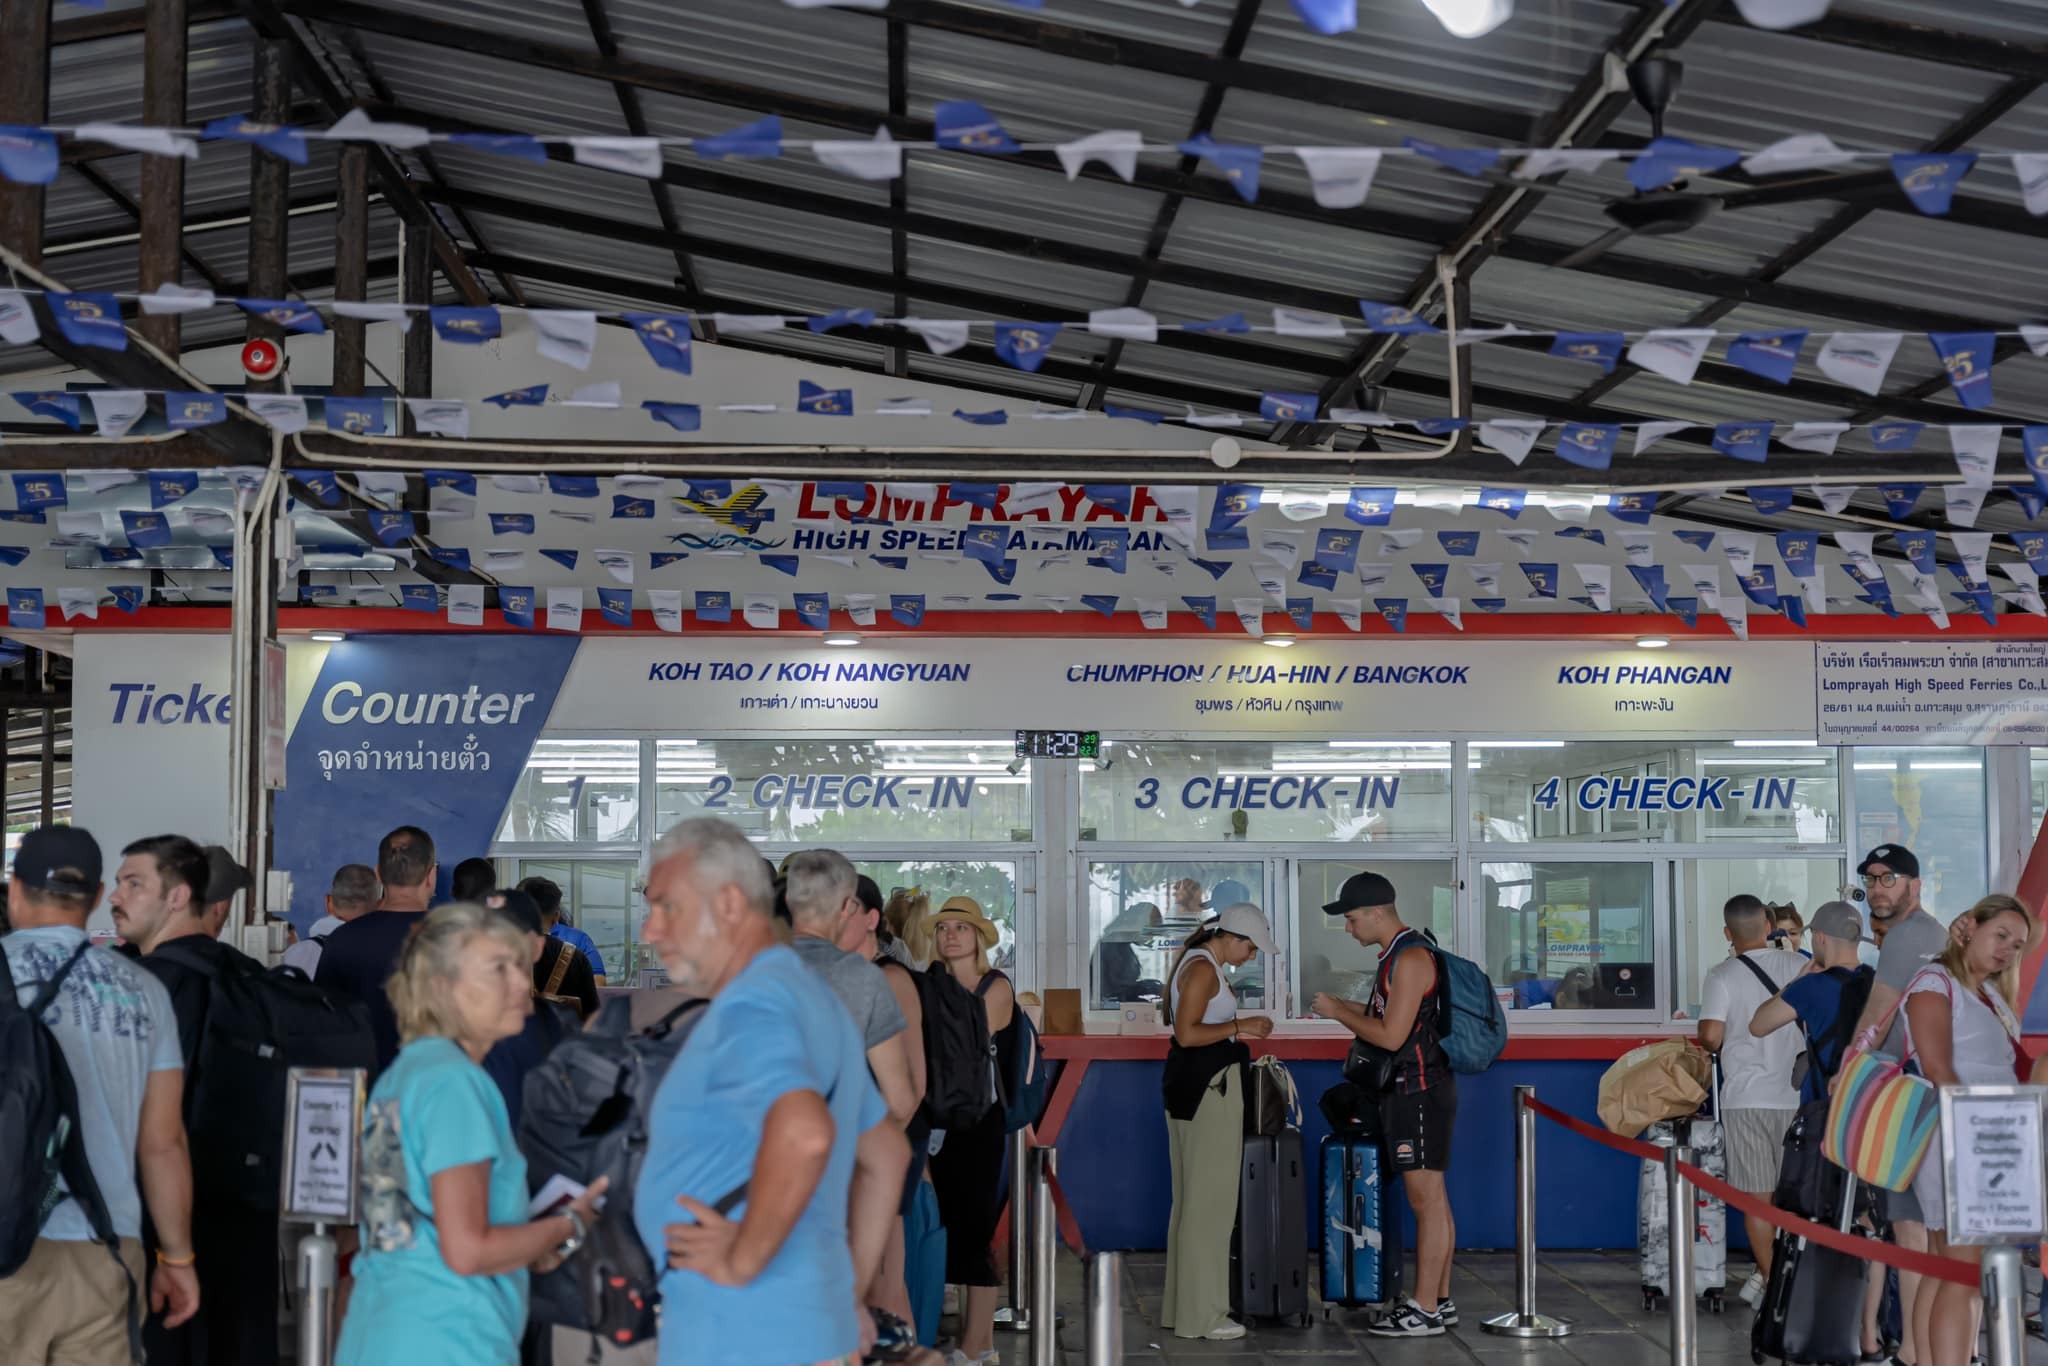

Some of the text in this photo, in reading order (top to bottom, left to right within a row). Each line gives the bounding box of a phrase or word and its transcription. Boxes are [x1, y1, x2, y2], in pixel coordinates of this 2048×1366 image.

[793, 529, 871, 550] HIGH
[880, 529, 975, 550] SPEE
[1823, 652, 1855, 668] บริษัท
[1859, 651, 1945, 668] เรือเร็วลมพระยา
[1950, 652, 1978, 668] จำกัด
[648, 662, 971, 683] KOH TAO / KOH NANGYUAN
[1066, 664, 1470, 685] CHUMPHON / HUA-HIN / BANGKOK
[1558, 666, 1732, 685] KOH PHANGAN
[1823, 678, 1889, 693] Lomprayah
[1895, 678, 1922, 693] High
[1928, 678, 1964, 693] Speed
[1970, 678, 2013, 690] Ferries
[109, 680, 535, 726] Ticke Counter
[740, 693, 788, 710] เกาะเต่า
[801, 697, 878, 710] เกาะนางยวน
[1195, 699, 1233, 715] ชุมพร
[1245, 697, 1282, 711] หัวหิน
[1295, 699, 1344, 715] กรุงเทพ
[1615, 697, 1674, 712] เกาะพะงัน
[1034, 733, 1079, 756] 11:29
[317, 732, 491, 782] จุดจำหน่ายตั๋ว
[566, 775, 587, 810] 1
[703, 774, 975, 808] 2 CHECK-IN
[1134, 776, 1401, 809] 3 CHECK-IN
[1534, 777, 1797, 811] 4 CHECK-IN
